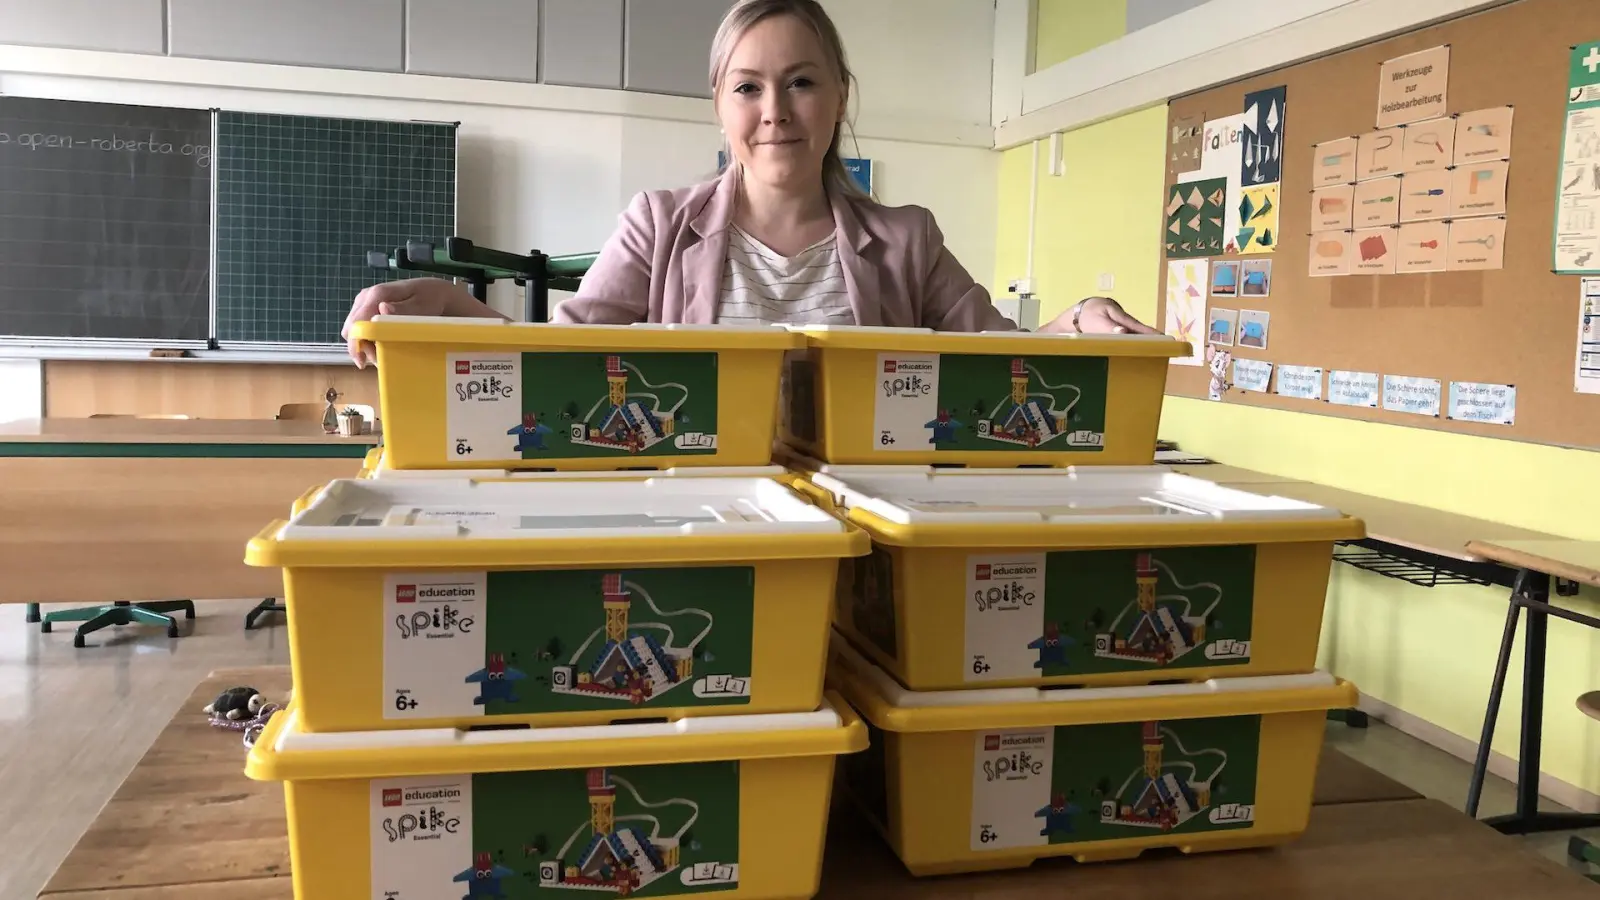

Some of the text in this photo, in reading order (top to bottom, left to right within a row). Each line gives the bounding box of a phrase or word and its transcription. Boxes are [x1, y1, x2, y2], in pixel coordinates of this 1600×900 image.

[1391, 64, 1433, 81] Werkzeuge
[1405, 84, 1417, 93] zur
[1381, 93, 1443, 114] Holzbearbeitung
[472, 363, 514, 371] education
[456, 376, 514, 402] spike
[883, 375, 931, 397] spike
[1387, 382, 1396, 391] Die
[1398, 384, 1418, 394] Schere
[1470, 386, 1490, 395] Schere
[1399, 396, 1417, 406] Papier
[881, 434, 896, 445] 6+
[456, 443, 474, 455] 6+
[993, 566, 1037, 575] education
[418, 587, 475, 598] education
[975, 581, 1036, 612] spike
[396, 605, 475, 640] spike
[973, 661, 991, 674] 6+
[395, 695, 419, 711] 6+
[1002, 736, 1045, 745] education
[983, 751, 1043, 782] spike
[404, 788, 461, 800] education
[383, 806, 461, 842] spike
[413, 833, 442, 841] Essential
[980, 830, 998, 843] 6+
